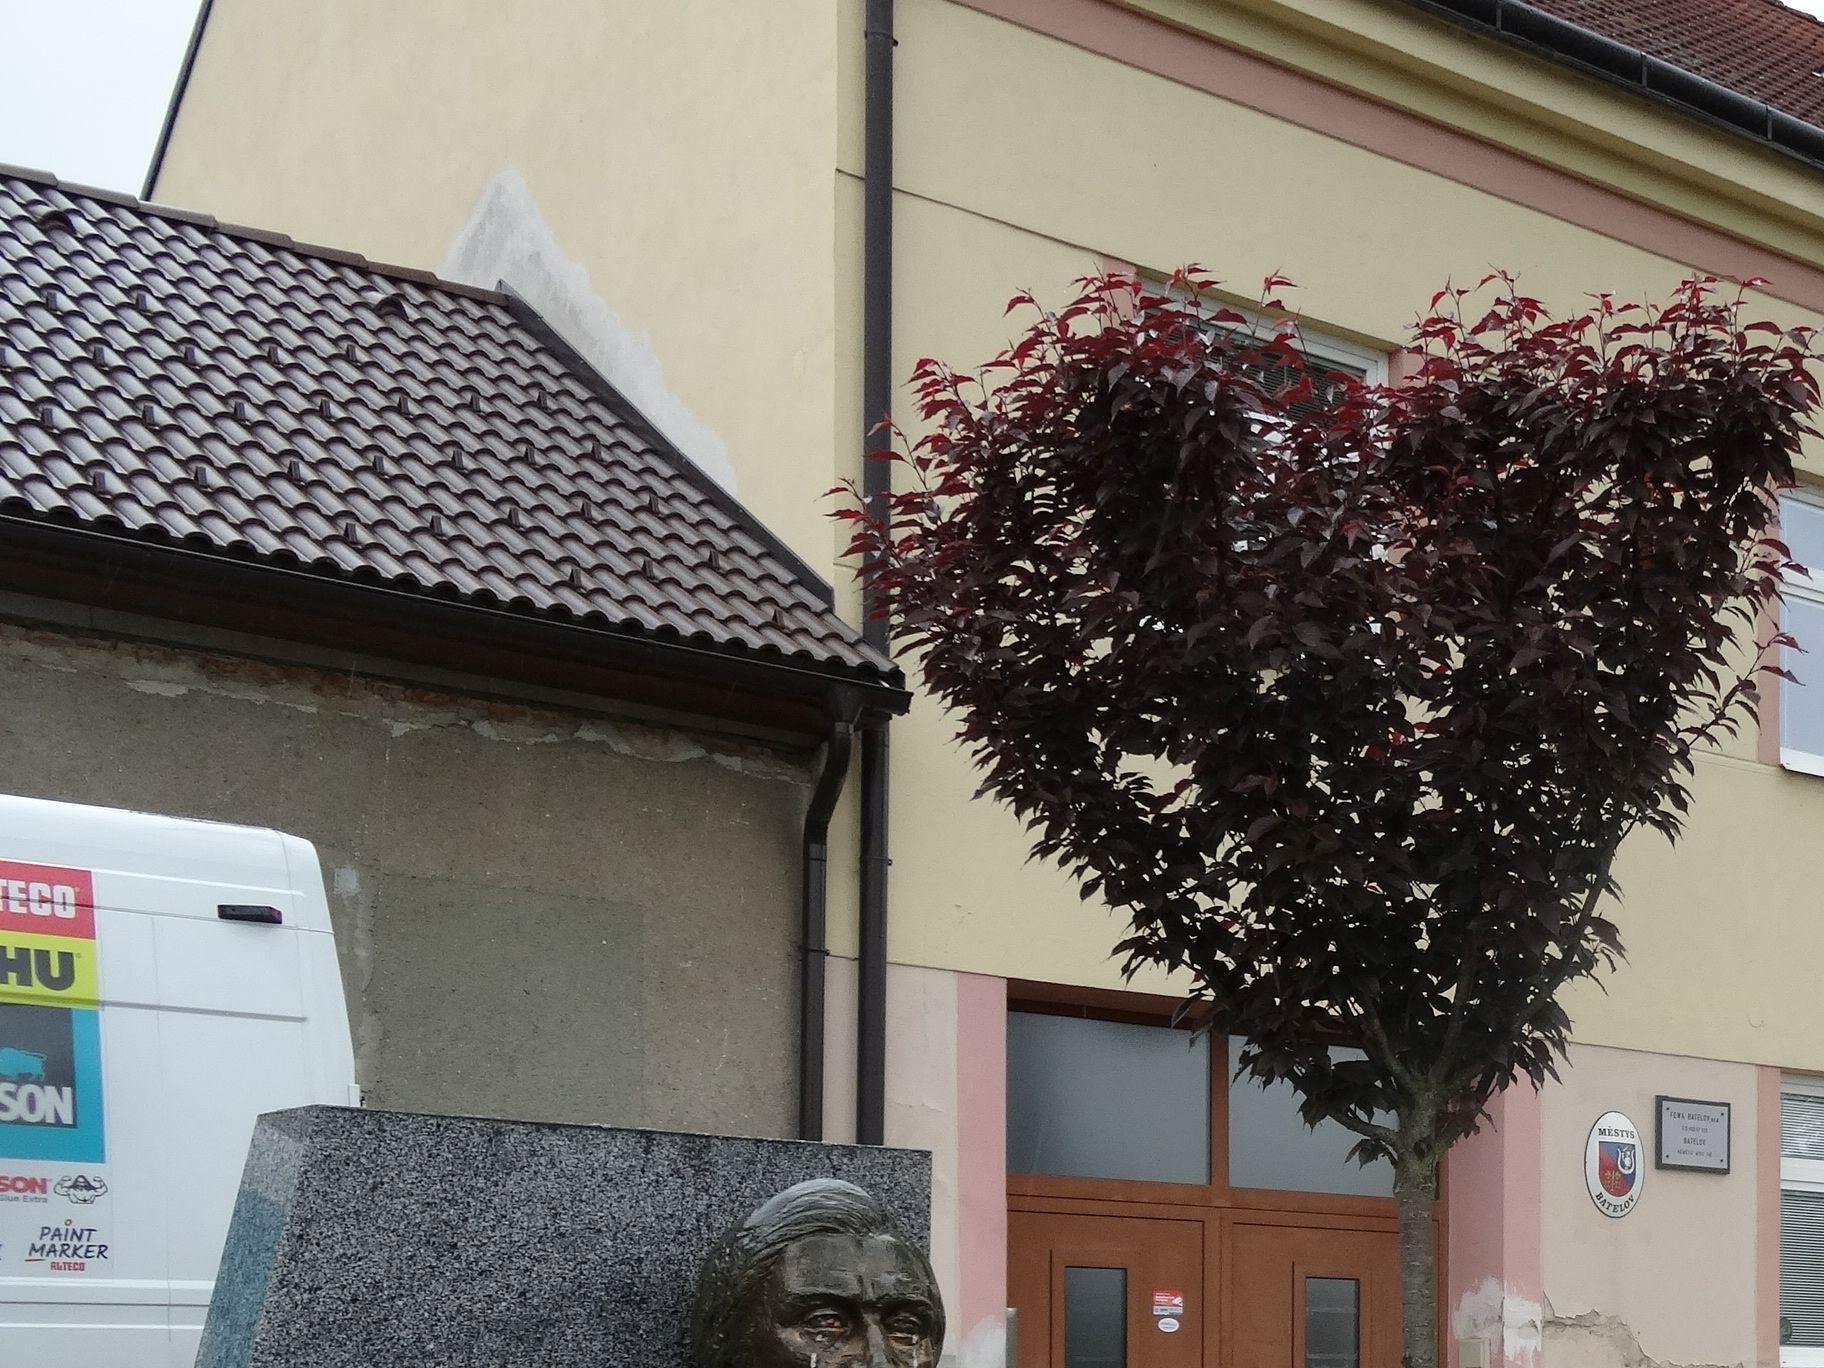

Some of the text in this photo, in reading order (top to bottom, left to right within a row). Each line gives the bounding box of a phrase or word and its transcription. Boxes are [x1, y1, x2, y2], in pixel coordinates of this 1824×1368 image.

[0, 1082, 74, 1125] SON
[1598, 1126, 1635, 1139] MĚSTYS
[1596, 1192, 1635, 1213] BATELOV
[40, 1221, 98, 1242] PAINT
[28, 1243, 109, 1259] MARKER
